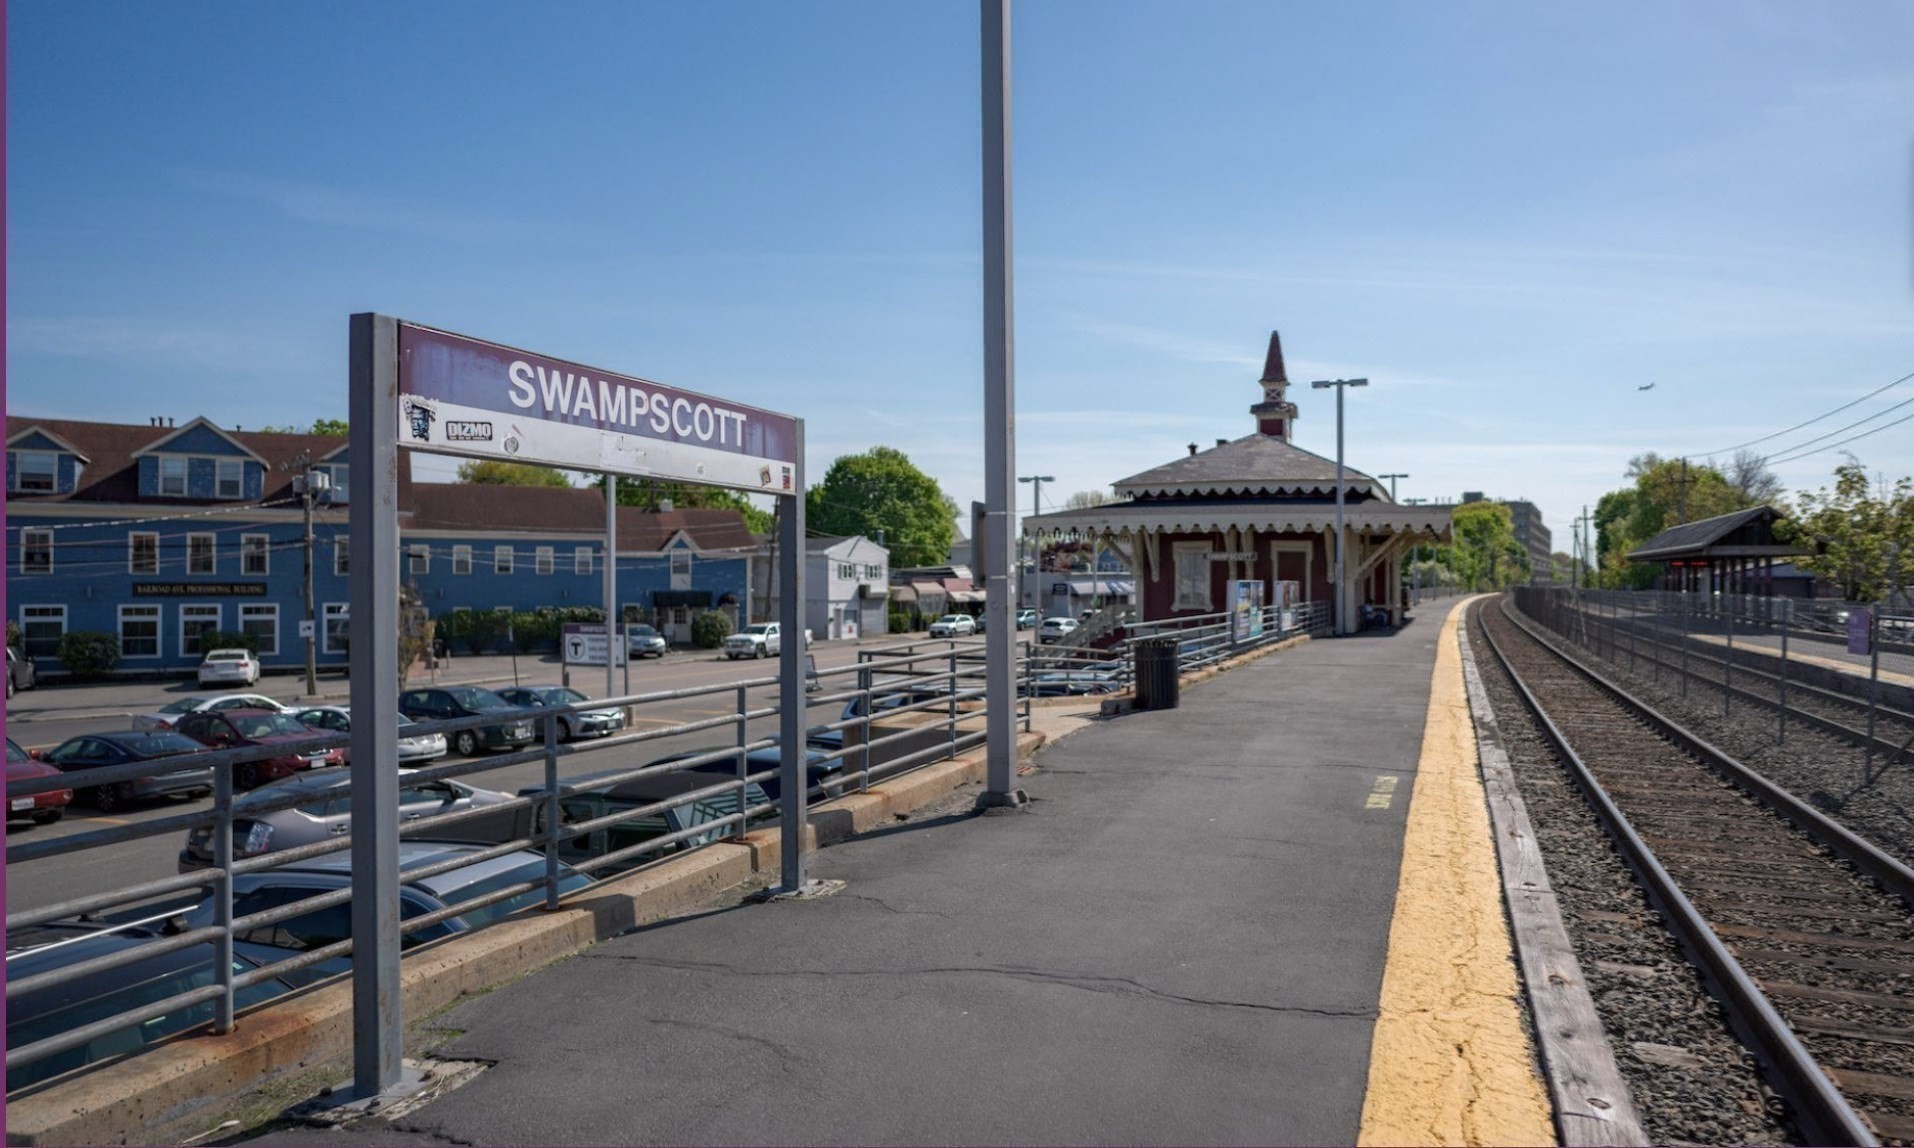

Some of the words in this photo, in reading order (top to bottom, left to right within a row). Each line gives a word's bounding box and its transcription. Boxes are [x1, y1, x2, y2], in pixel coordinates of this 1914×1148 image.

[508, 361, 747, 447] SWAMPSCOTT
[447, 422, 492, 437] DIZMO
[571, 642, 581, 656] T
